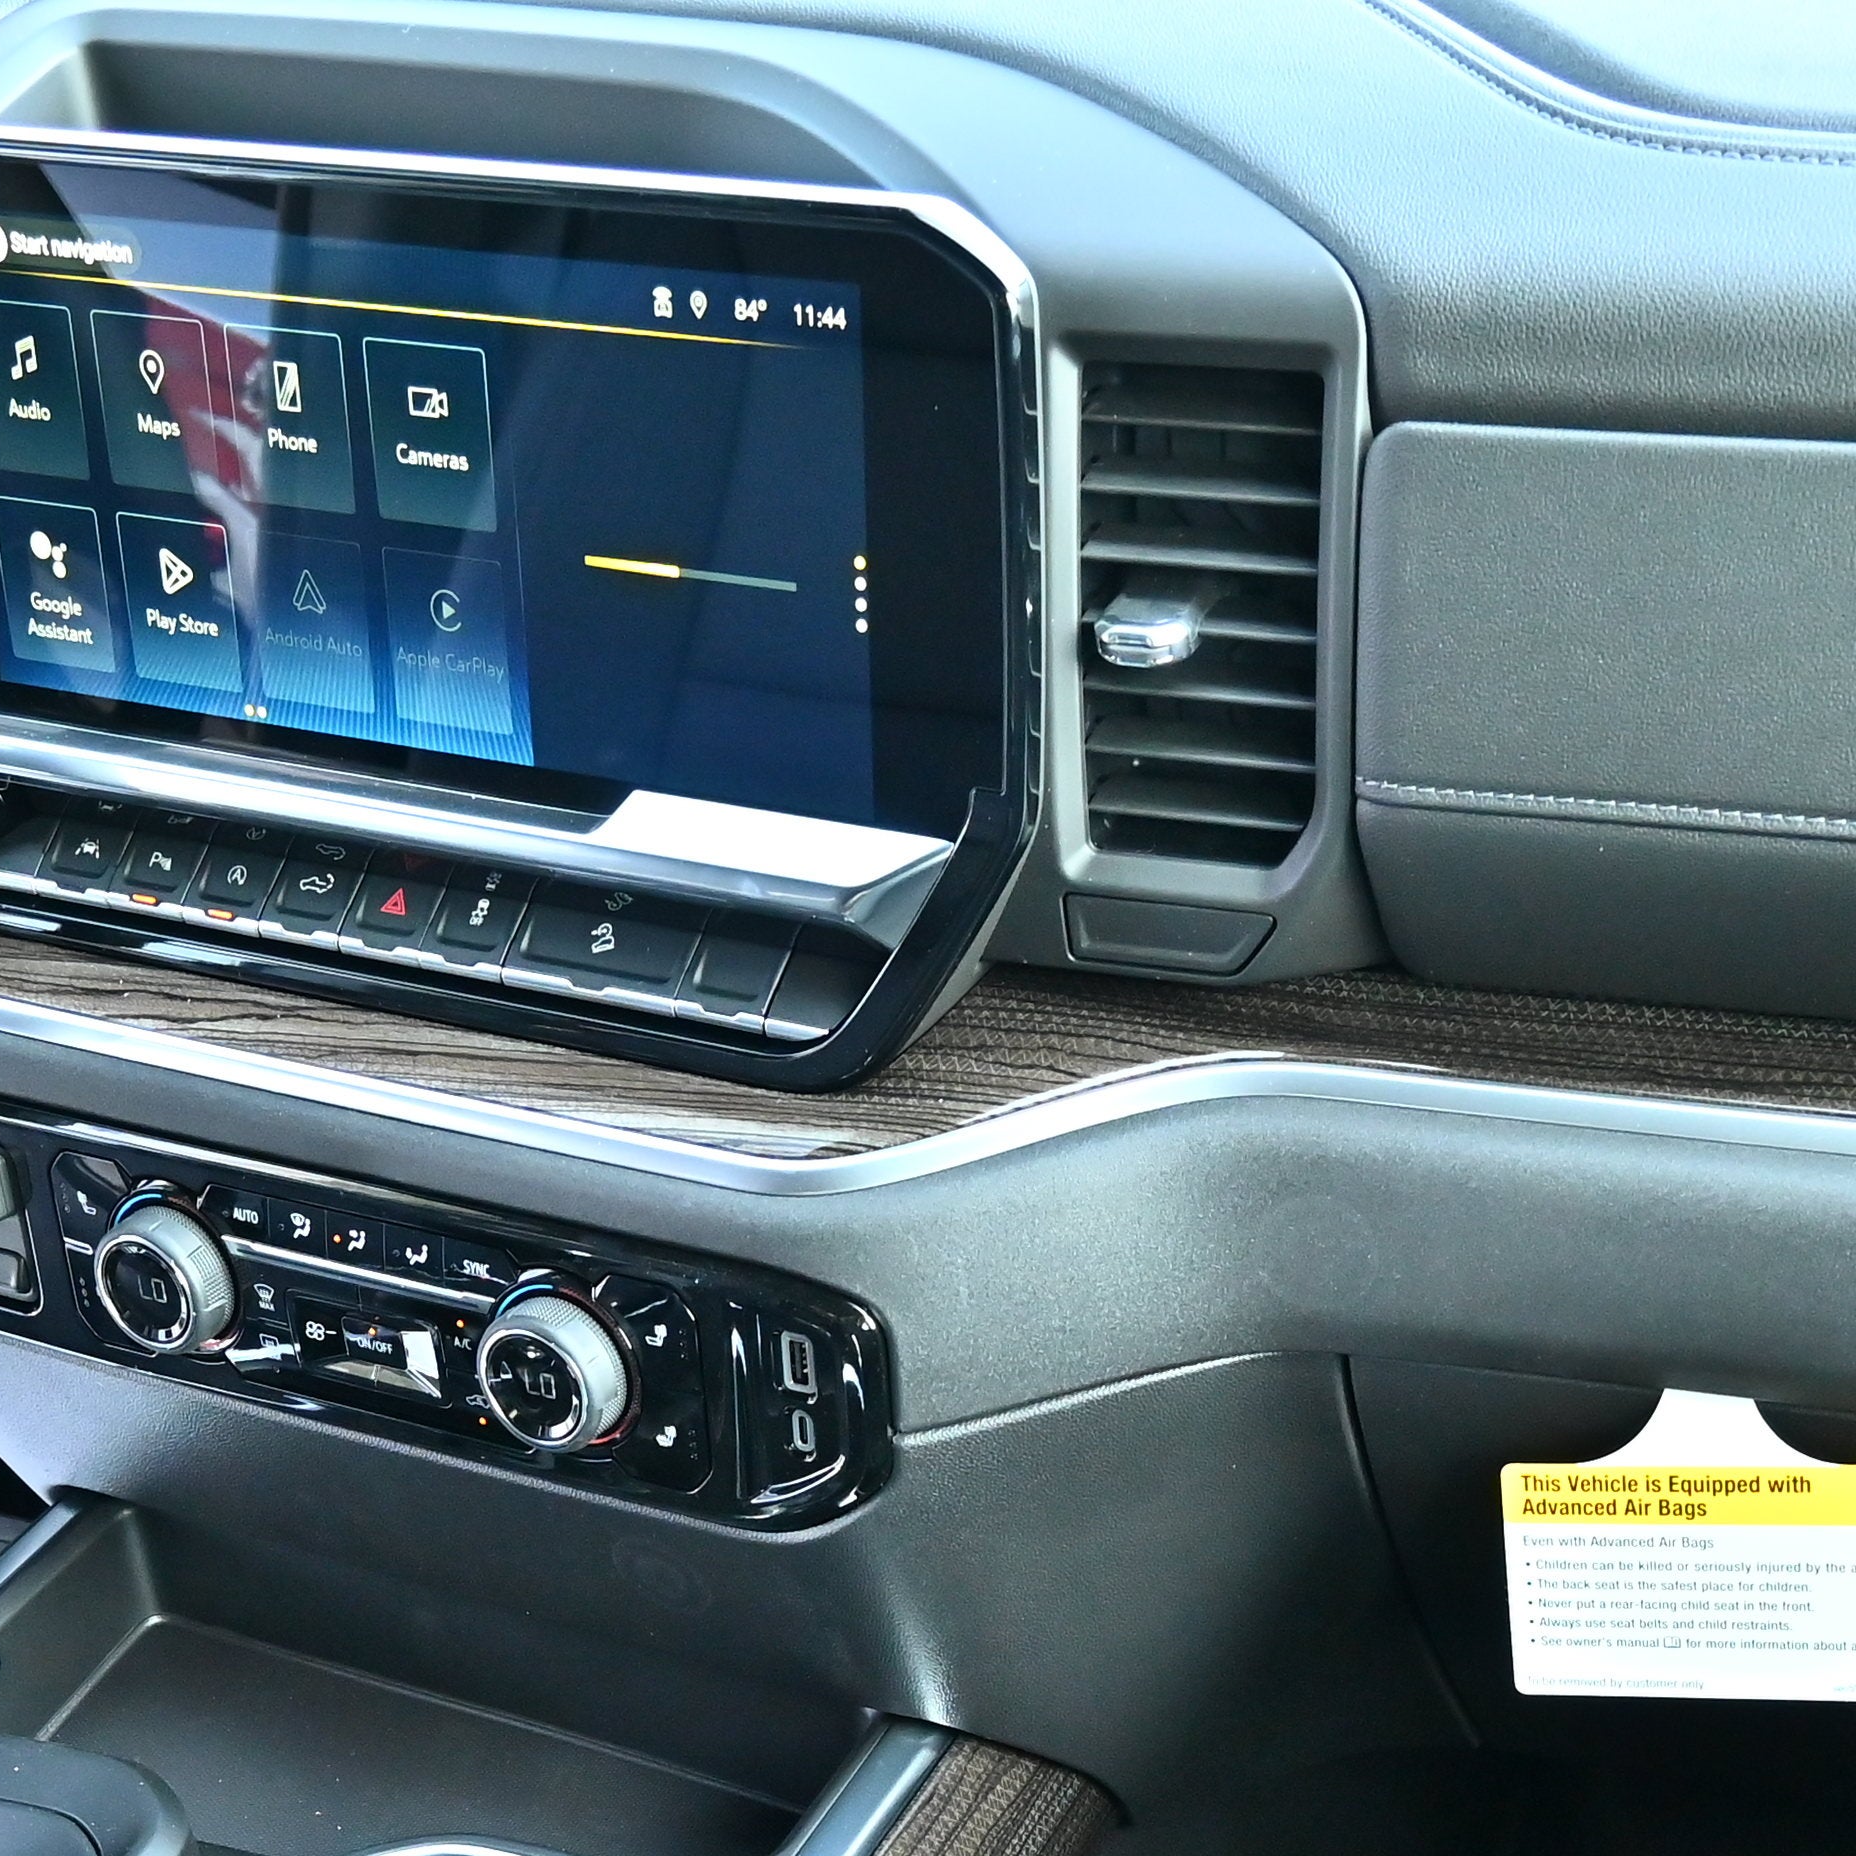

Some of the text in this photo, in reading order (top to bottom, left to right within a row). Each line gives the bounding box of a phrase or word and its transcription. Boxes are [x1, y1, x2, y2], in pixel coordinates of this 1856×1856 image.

[9, 230, 133, 265] Start navigation
[734, 298, 847, 330] 84° 11:44
[8, 398, 51, 421] Audio
[136, 412, 181, 440] Maps
[267, 427, 318, 454] Phone
[395, 442, 469, 472] Cameras
[30, 591, 82, 620] Google
[28, 618, 93, 645] Assistant
[146, 608, 219, 637] Play Store
[265, 627, 362, 657] Android Auto
[397, 646, 505, 684] Apple CarPlay
[232, 1207, 259, 1225] AUTO
[462, 1258, 490, 1278] SYNC
[258, 1300, 276, 1312] MAX
[357, 1335, 393, 1355] ON/OFF
[453, 1335, 472, 1351] A/C
[1521, 1475, 1811, 1497] This Vehicle is Equipped with
[1522, 1498, 1708, 1521] Advanced Air Bags
[1523, 1535, 1714, 1550] Even with Advanced Air Bags
[1535, 1559, 1588, 1570] Children
[1592, 1562, 1614, 1571] can
[1618, 1560, 1634, 1571] be
[1638, 1560, 1672, 1571] killed
[1677, 1562, 1689, 1572] or
[1694, 1561, 1751, 1574] seriously
[1757, 1562, 1801, 1574] injured
[1806, 1562, 1821, 1575] by
[1826, 1562, 1846, 1573] the
[1537, 1578, 1813, 1593] The back seat is the safest place for children.
[1538, 1598, 1572, 1608] Never
[1576, 1600, 1595, 1610] put
[1610, 1600, 1677, 1612] rear-facing
[1681, 1600, 1710, 1611] child
[1714, 1601, 1740, 1611] seat
[1744, 1601, 1754, 1611] in
[1759, 1601, 1778, 1611] the
[1782, 1601, 1814, 1612] front.
[1539, 1617, 1793, 1631] Always use seat belts and child restraints.
[1541, 1636, 1562, 1646] See
[1566, 1637, 1612, 1647] owner's
[1616, 1637, 1660, 1648] manual
[1686, 1638, 1701, 1648] for
[1705, 1640, 1736, 1649] more
[1740, 1639, 1809, 1650] information
[1813, 1640, 1847, 1651] about
[1559, 1677, 1606, 1687] removed
[1610, 1678, 1623, 1689] by
[1626, 1679, 1677, 1689] customer
[1681, 1680, 1704, 1690] only
